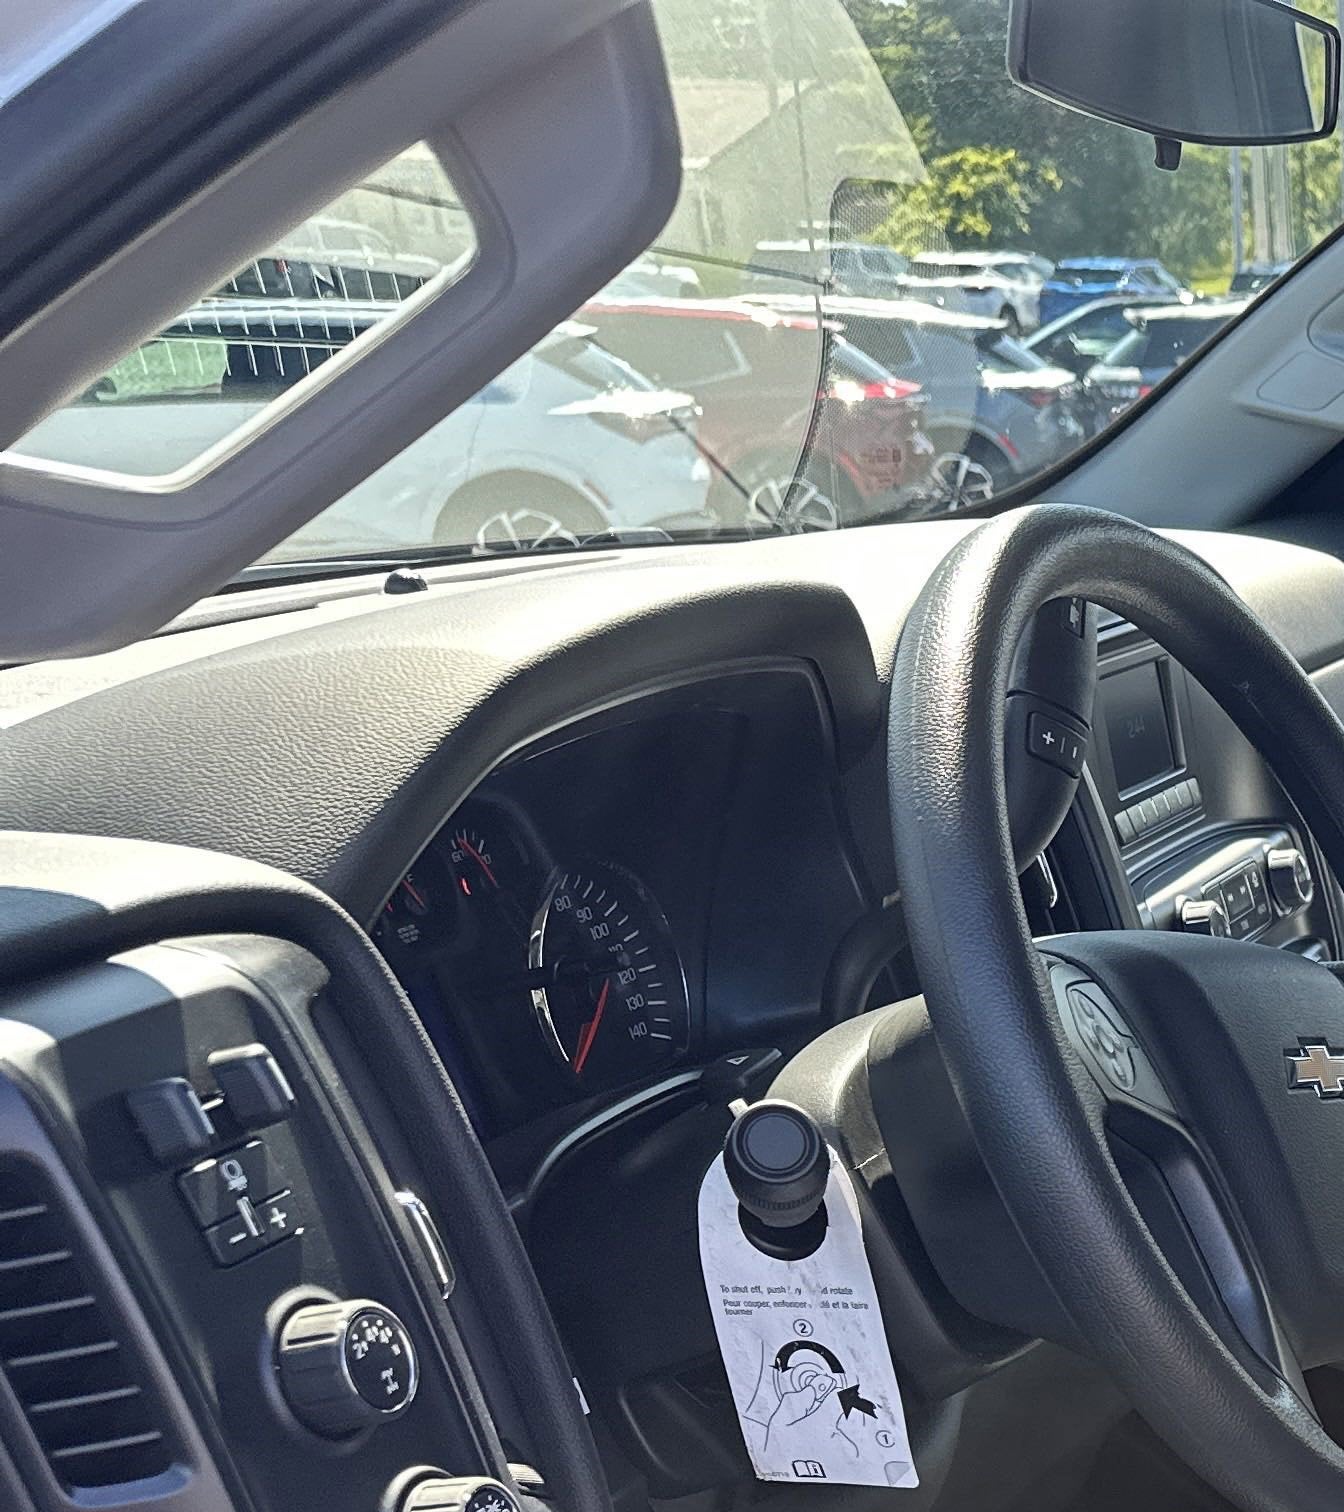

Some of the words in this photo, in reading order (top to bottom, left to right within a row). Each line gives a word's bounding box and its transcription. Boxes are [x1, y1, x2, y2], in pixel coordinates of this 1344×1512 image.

[554, 895, 572, 912] 80
[576, 907, 593, 923] 90
[589, 922, 610, 941] 100
[617, 967, 637, 985] 120
[625, 993, 645, 1011] 130
[628, 1021, 648, 1040] 140
[720, 1285, 729, 1293] To
